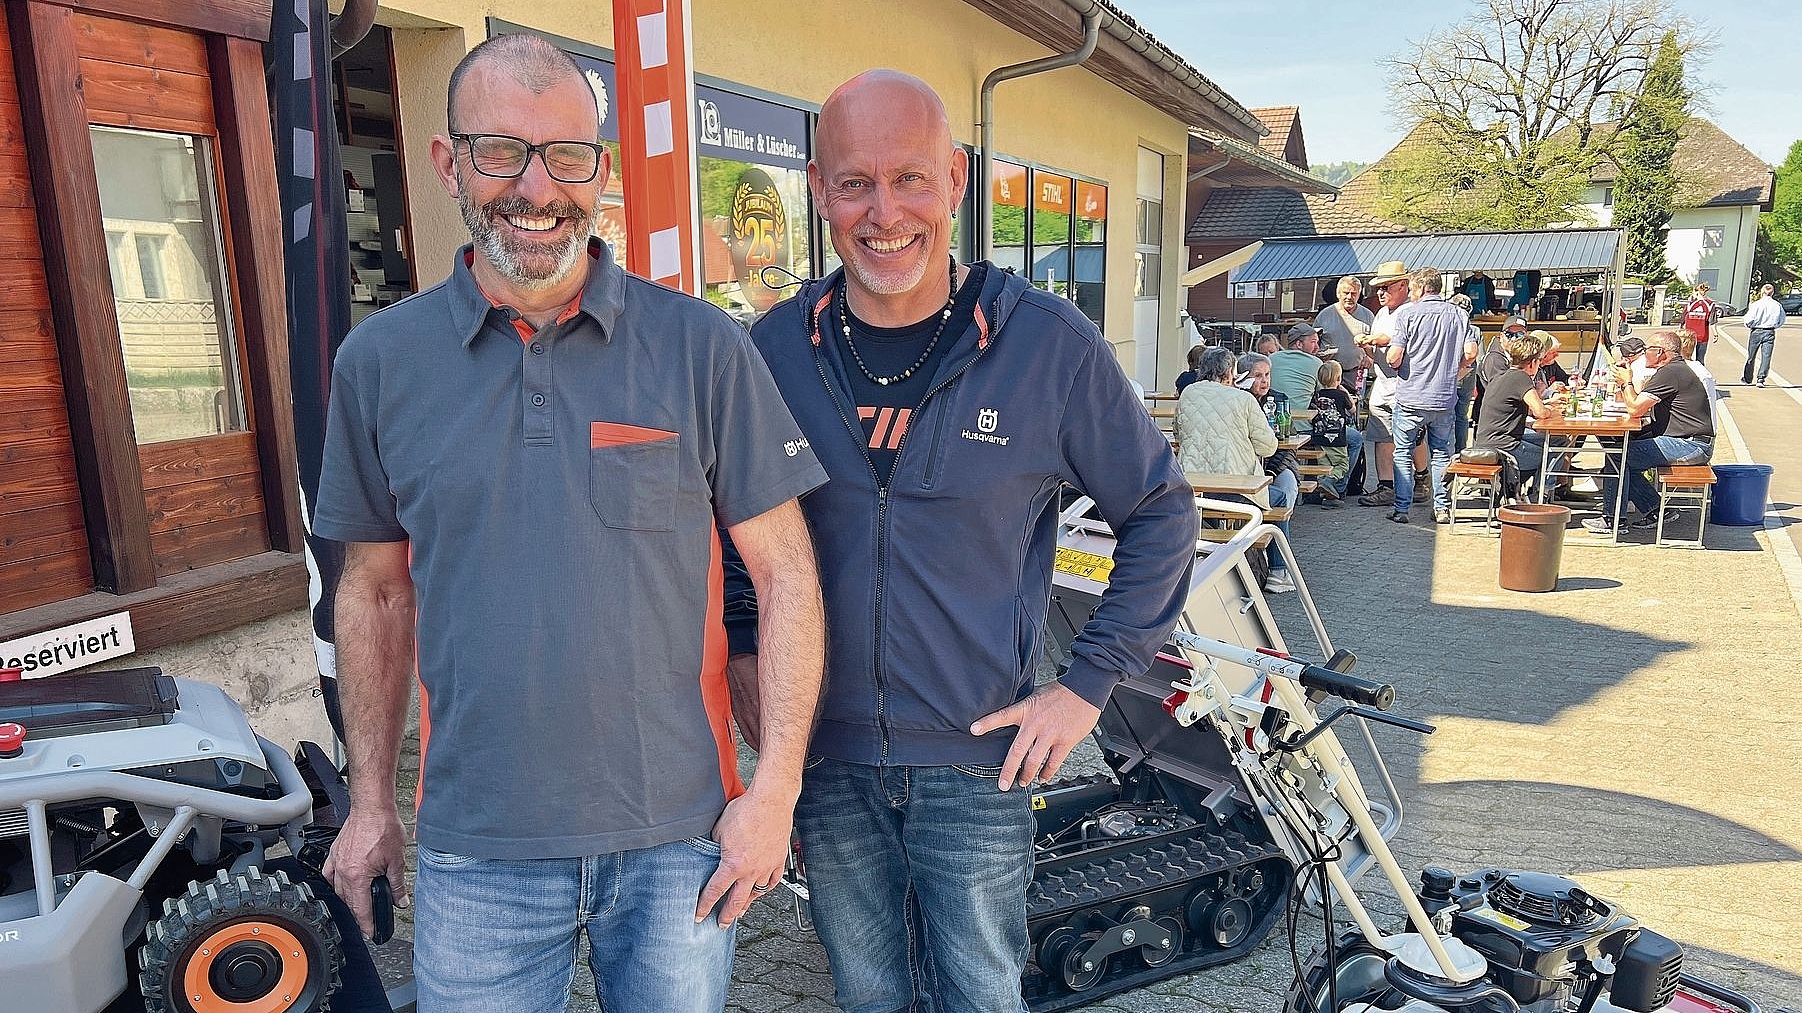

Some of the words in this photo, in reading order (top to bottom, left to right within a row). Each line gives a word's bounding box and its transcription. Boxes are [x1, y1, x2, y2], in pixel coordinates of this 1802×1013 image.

[723, 127, 754, 152] Müller
[757, 133, 765, 153] &
[766, 135, 797, 158] Lüscher
[1042, 182, 1063, 204] STIHL
[744, 216, 776, 267] 25
[961, 429, 1007, 446] Husqvarna
[0, 626, 120, 672] eserviert
